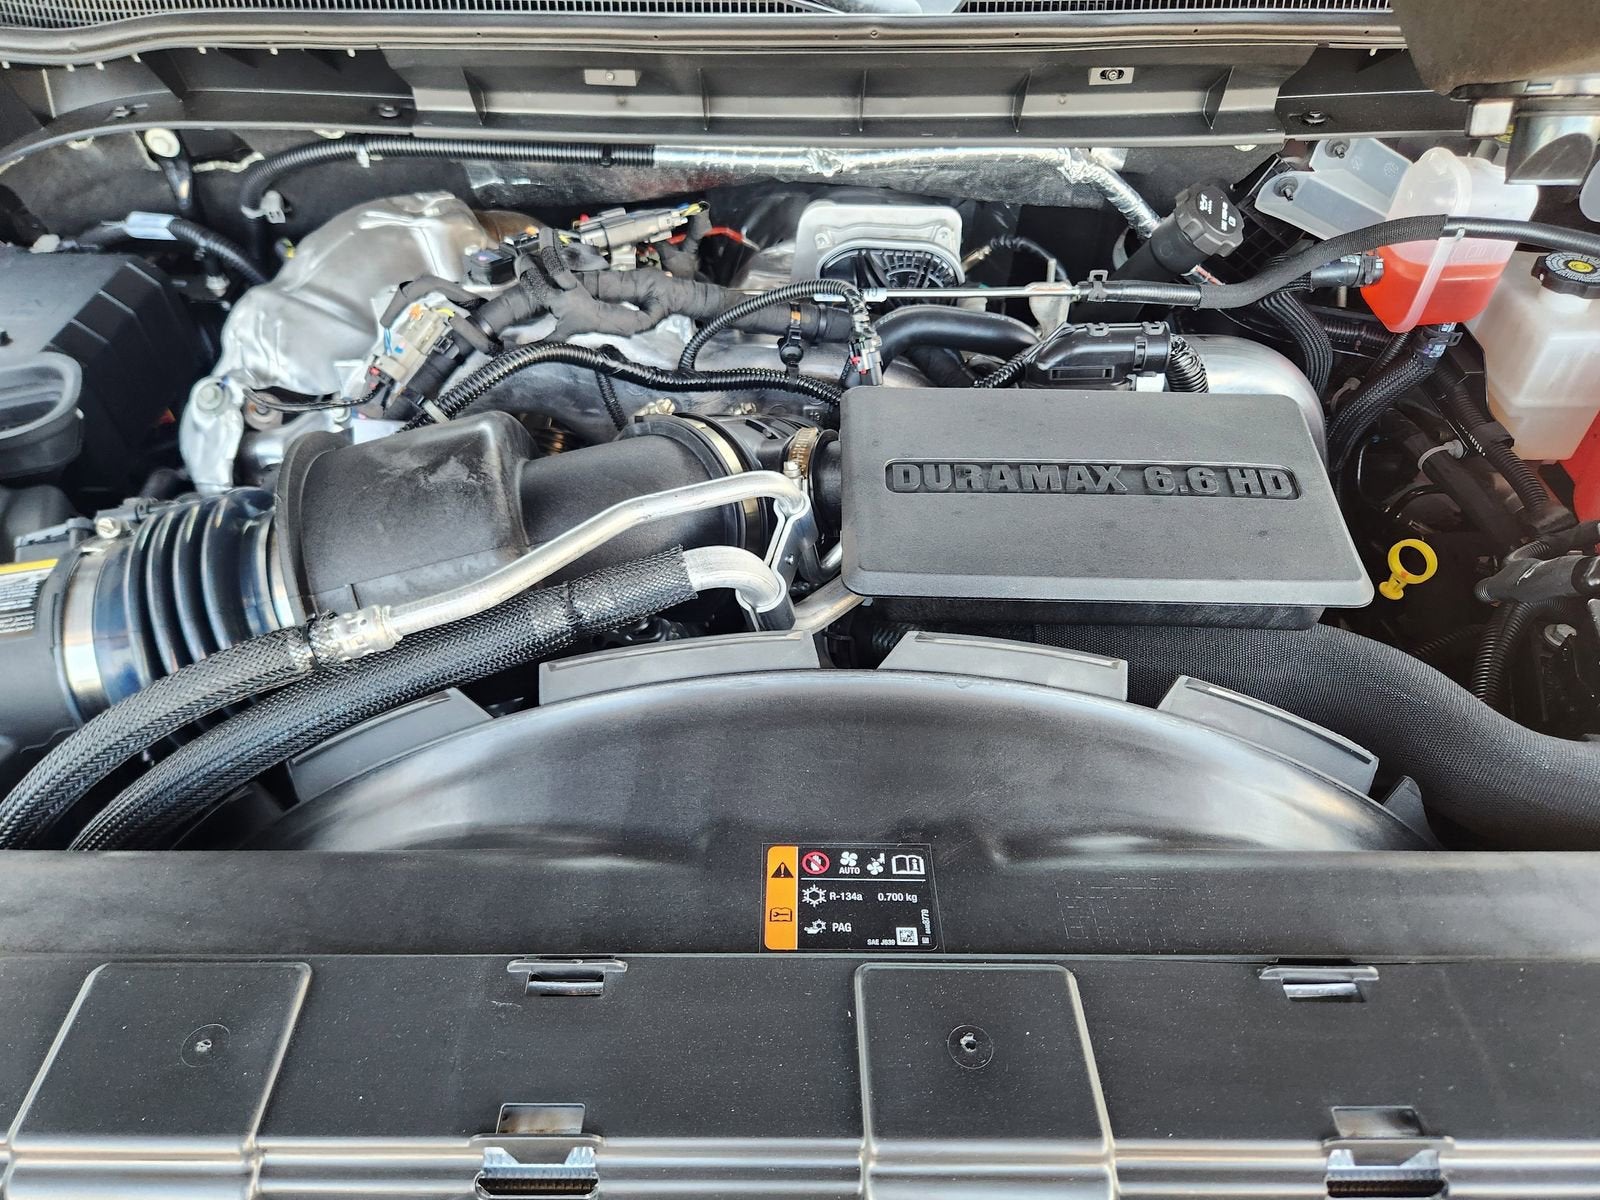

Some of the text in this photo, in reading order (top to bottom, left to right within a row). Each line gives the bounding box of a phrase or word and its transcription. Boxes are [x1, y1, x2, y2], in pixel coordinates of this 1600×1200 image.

[891, 463, 1294, 497] DURAMAX 6.6 HD
[829, 892, 918, 903] R-134a 0.700 kg
[832, 923, 852, 932] PAG
